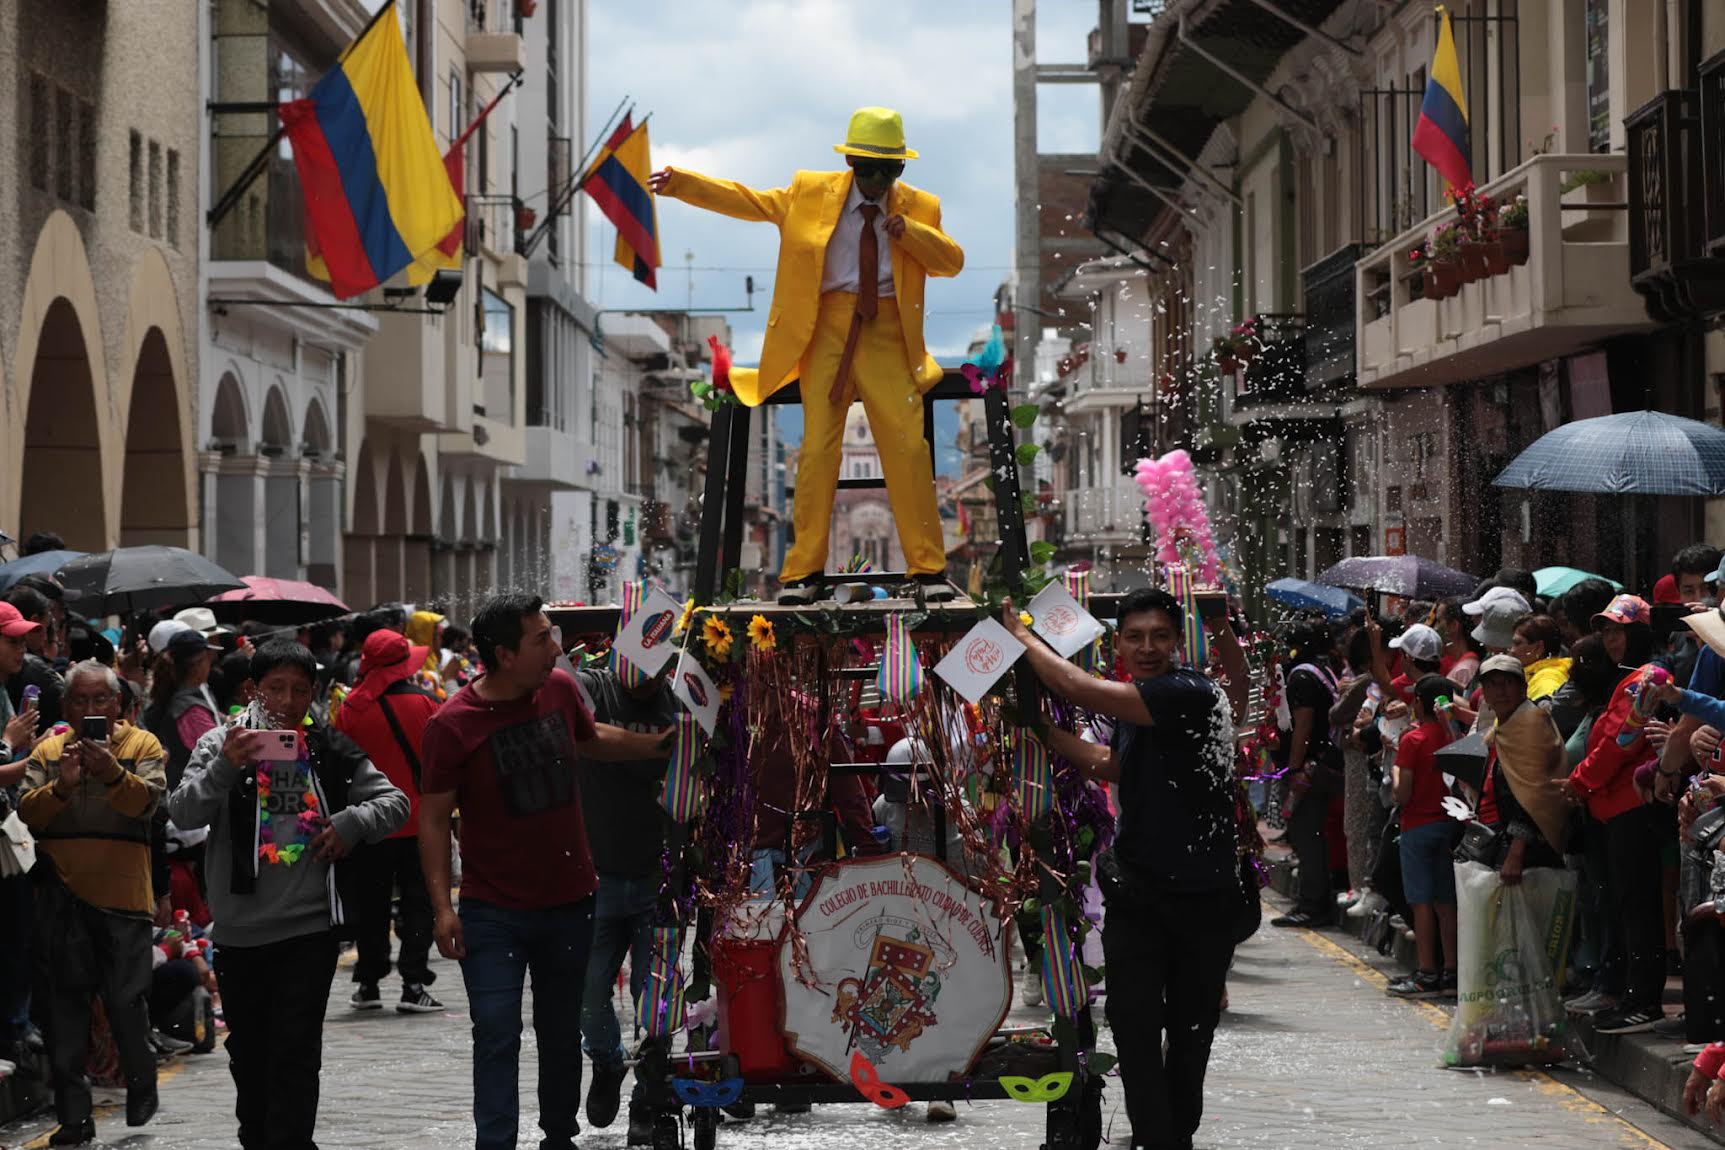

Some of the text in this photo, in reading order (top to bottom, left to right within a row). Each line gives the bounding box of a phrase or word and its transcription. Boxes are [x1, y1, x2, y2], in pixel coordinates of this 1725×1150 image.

[650, 613, 672, 639] ITALIANA
[820, 888, 857, 917] COLEGIO
[856, 882, 870, 900] DE
[870, 880, 932, 901] BACHILLERATO
